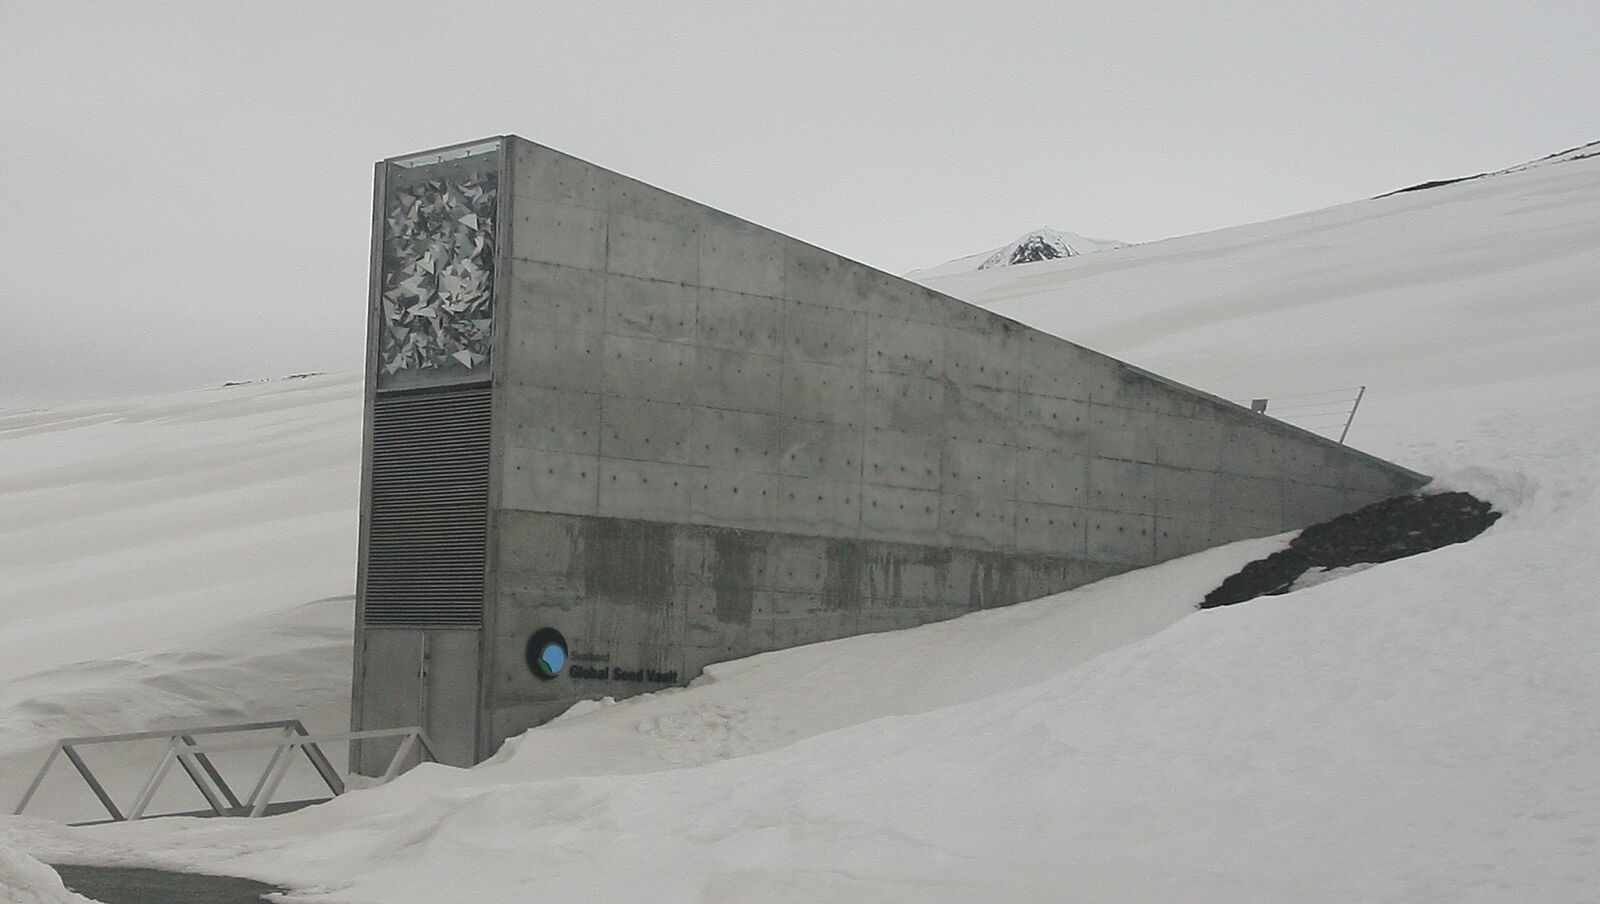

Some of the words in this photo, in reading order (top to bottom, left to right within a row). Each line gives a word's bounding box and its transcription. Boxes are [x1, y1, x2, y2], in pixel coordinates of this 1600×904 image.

[570, 665, 609, 680] Global
[613, 667, 643, 682] Seed
[646, 668, 678, 683] Vault
